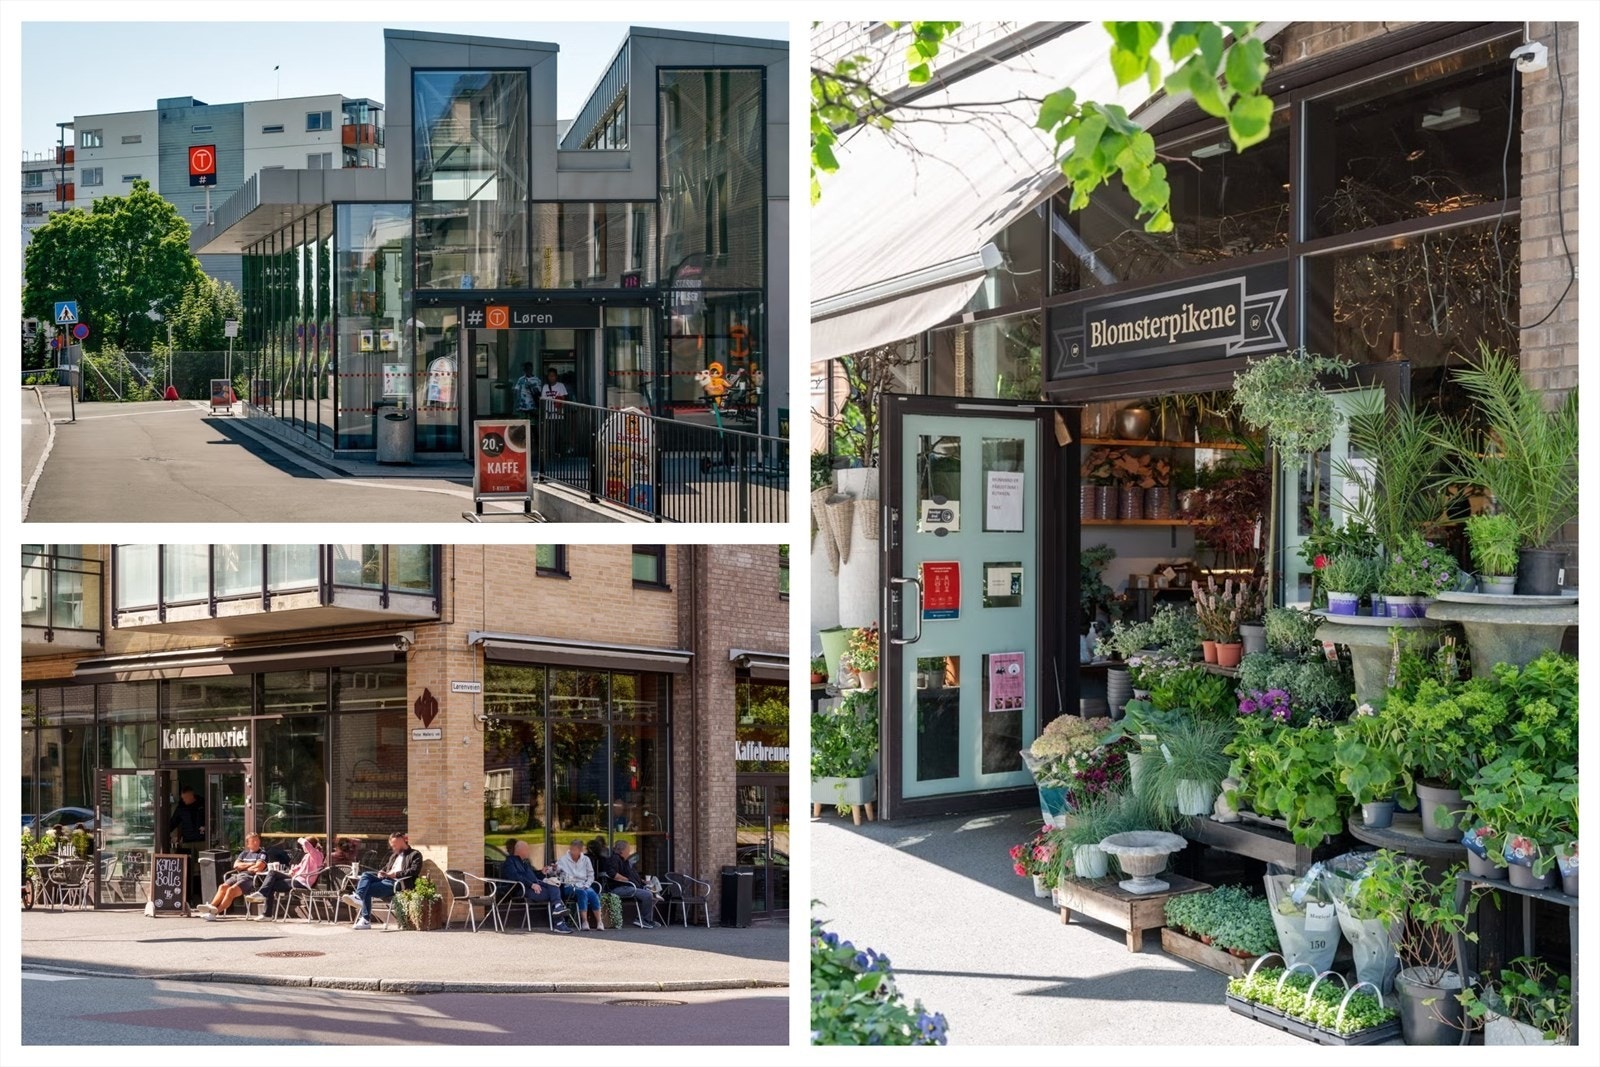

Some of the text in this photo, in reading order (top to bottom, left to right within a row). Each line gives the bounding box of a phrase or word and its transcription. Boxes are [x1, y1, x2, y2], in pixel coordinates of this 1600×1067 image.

[513, 311, 553, 324] Løren
[1090, 303, 1237, 348] Blomsterpikene
[482, 438, 503, 451] 20,-
[487, 461, 519, 474] KAFFE
[162, 726, 248, 749] Kaffebrenneriet
[155, 871, 182, 887] Bolle
[1310, 940, 1326, 949] 150
